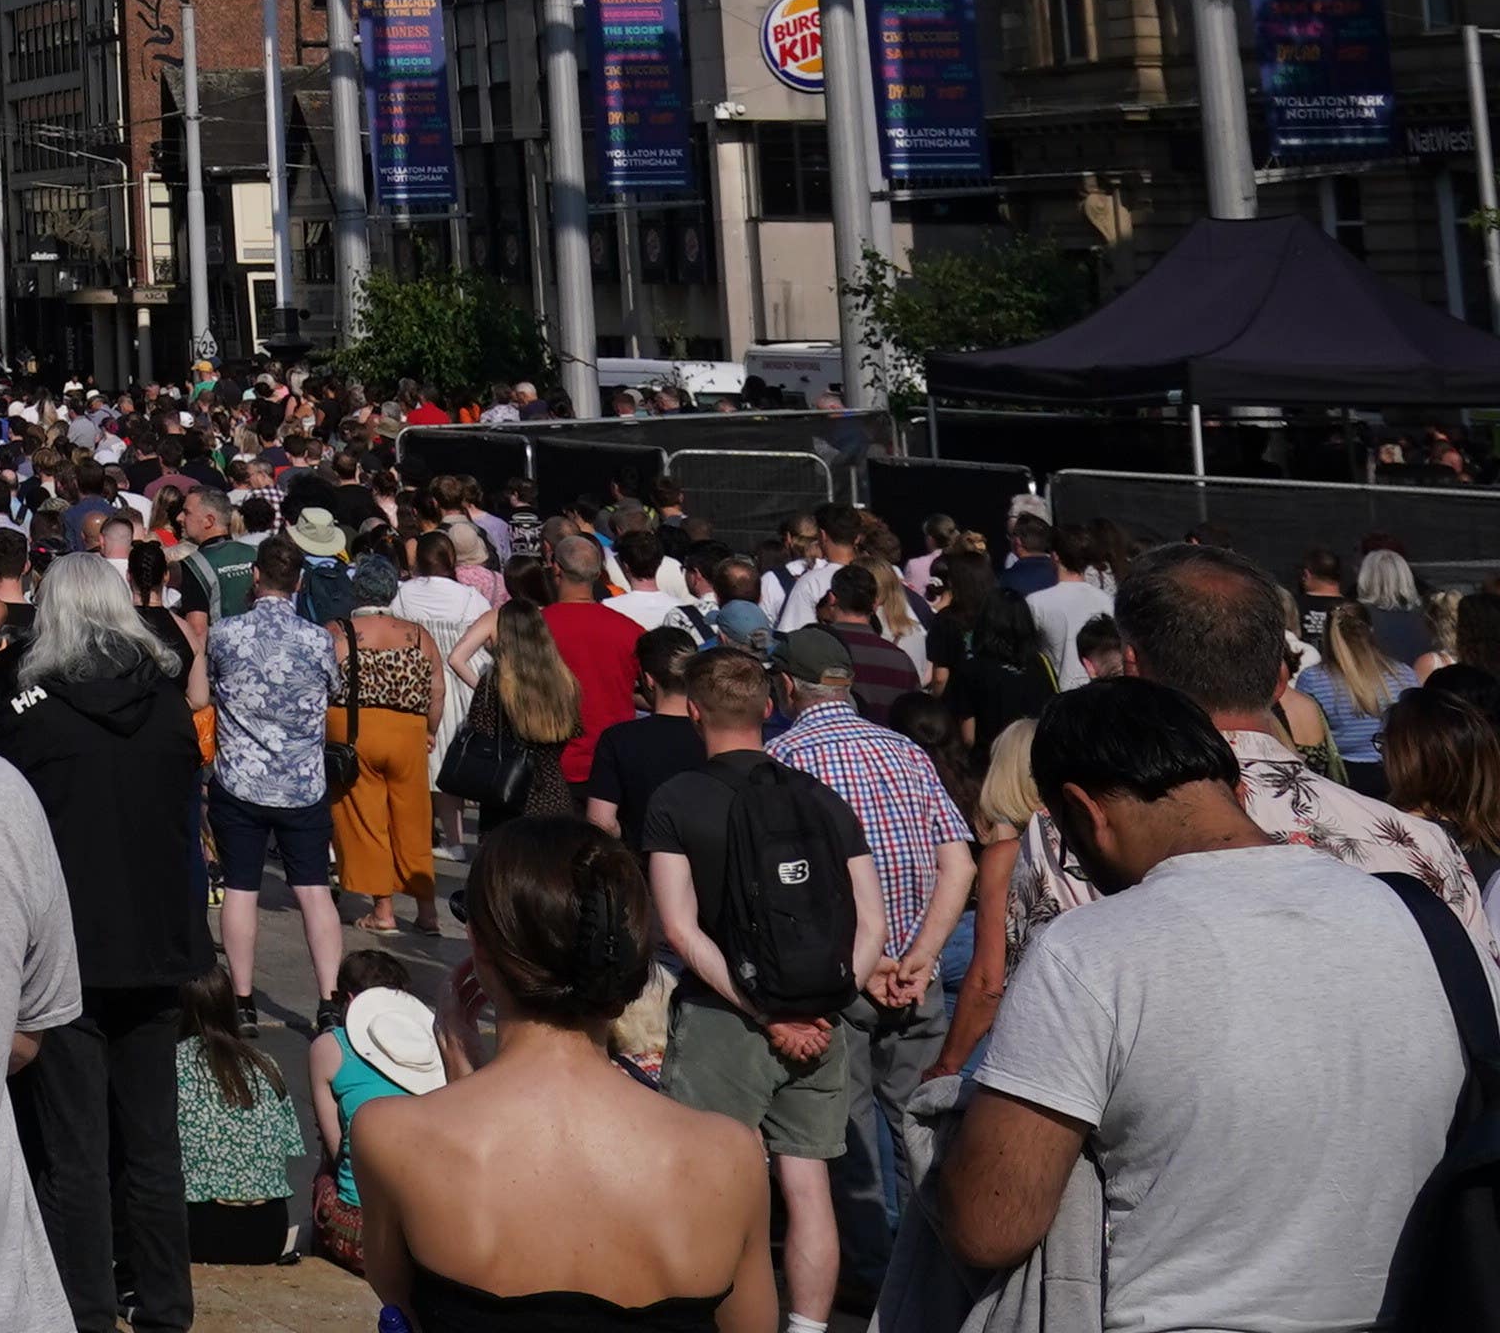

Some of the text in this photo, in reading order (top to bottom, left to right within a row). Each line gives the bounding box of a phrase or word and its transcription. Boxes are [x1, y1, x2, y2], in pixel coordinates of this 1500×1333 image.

[772, 11, 821, 44] BURG
[779, 32, 823, 69] KIN
[1273, 95, 1385, 107] WOLLATON PARK
[1286, 107, 1376, 120] NOTTINGHAM
[885, 128, 977, 138] WOLLATON PARK
[894, 138, 970, 148] NOTTINGHAM
[1407, 128, 1477, 153] NatWest
[605, 148, 684, 159] WOLLATON PARK
[613, 158, 678, 167] NOTTINGHAM
[201, 341, 215, 355] 25
[10, 685, 48, 714] HH
